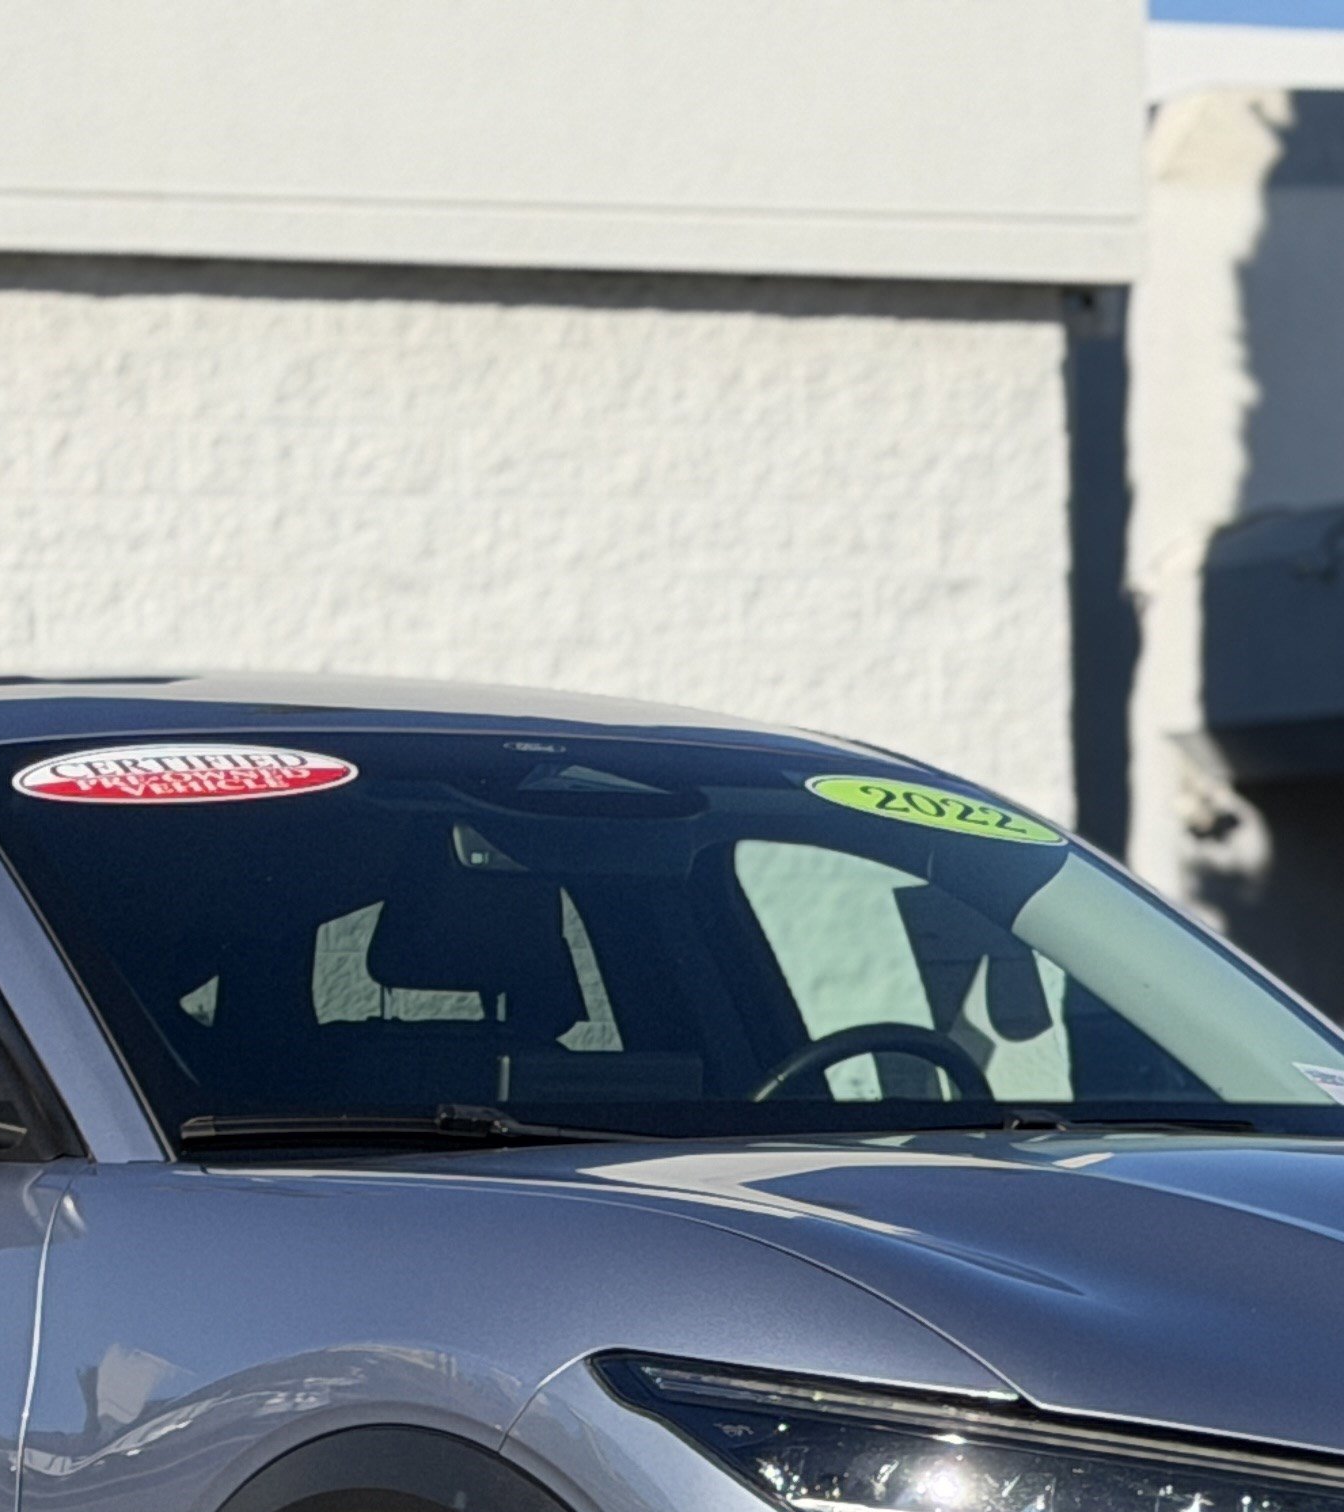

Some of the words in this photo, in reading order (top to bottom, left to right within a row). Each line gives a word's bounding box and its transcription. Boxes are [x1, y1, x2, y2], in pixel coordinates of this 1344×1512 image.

[48, 752, 309, 780] CERTIFIED
[74, 766, 311, 791] PRE-OWNED
[122, 772, 293, 798] VEHICLE
[859, 784, 1028, 835] 2022
